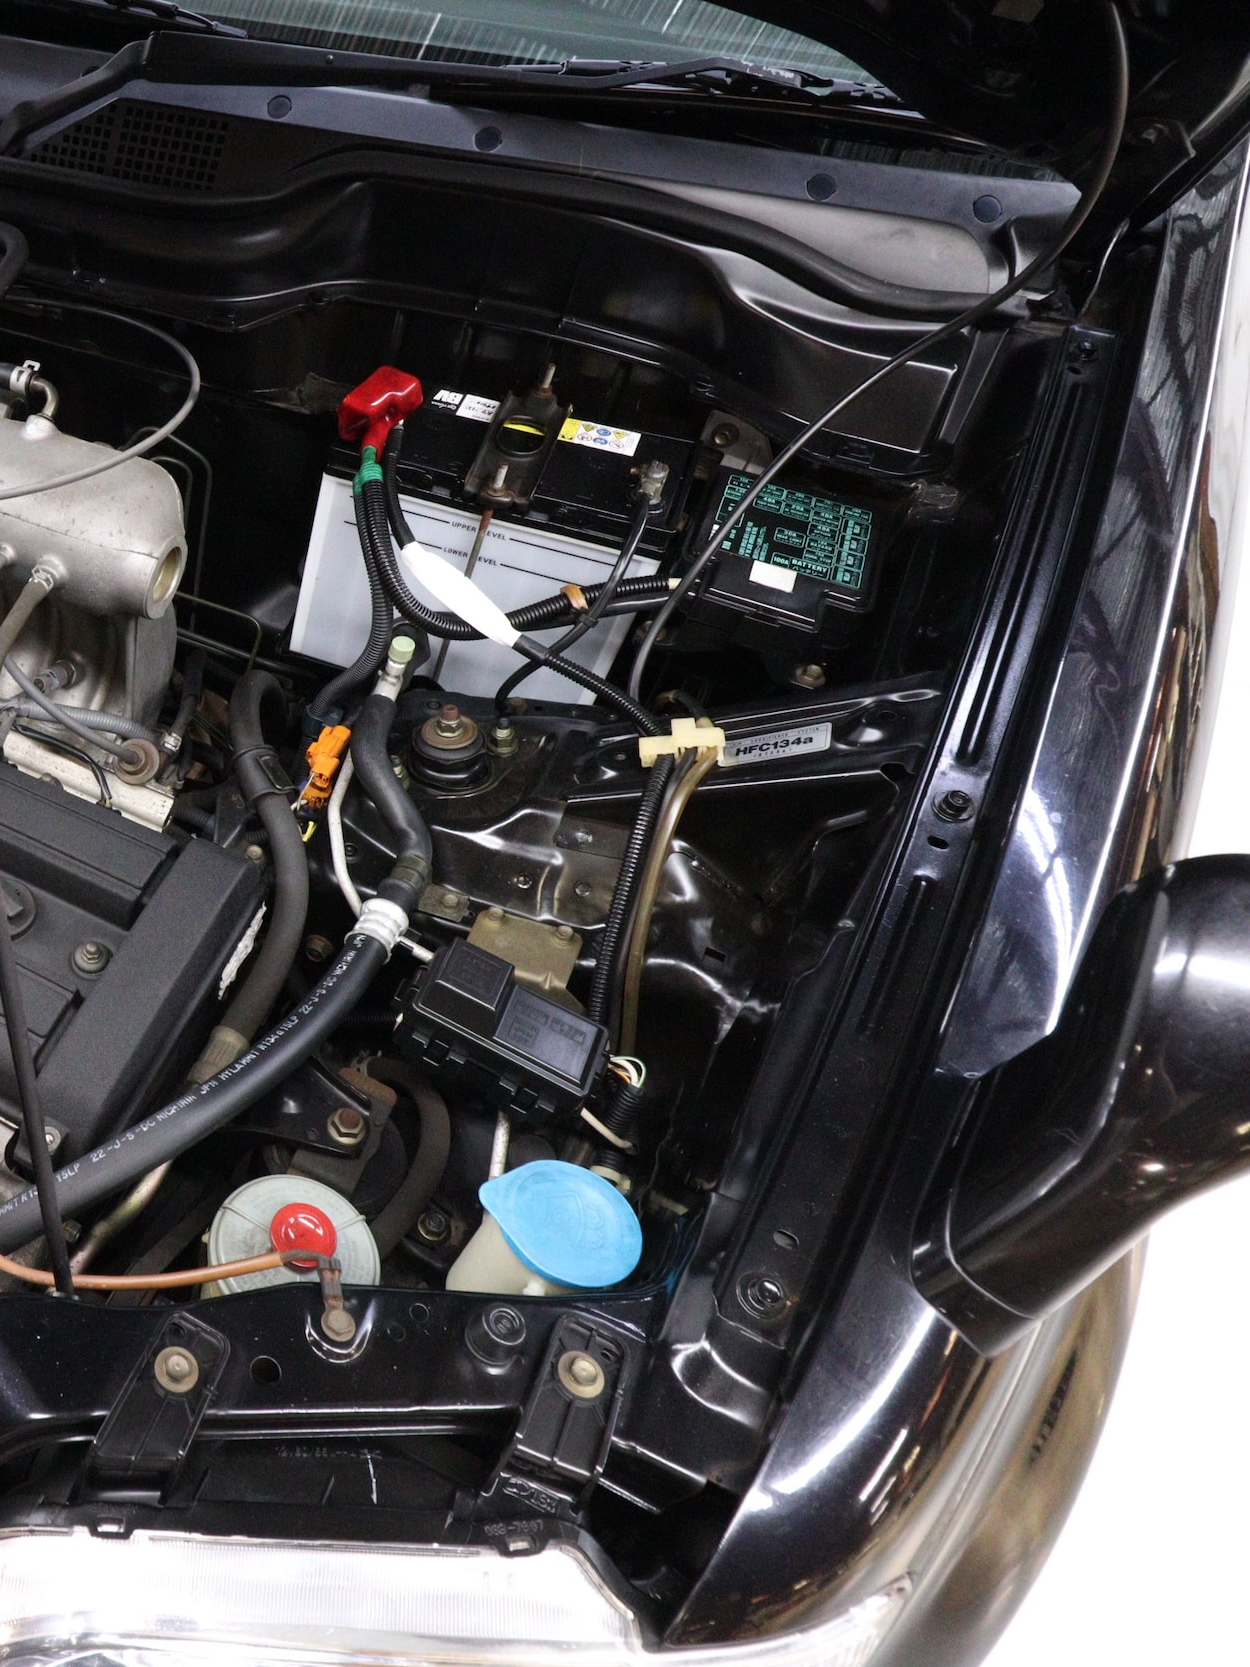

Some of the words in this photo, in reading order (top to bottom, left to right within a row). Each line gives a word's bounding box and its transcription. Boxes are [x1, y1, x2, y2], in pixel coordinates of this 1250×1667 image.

[452, 521, 477, 532] UPPER
[487, 530, 506, 540] EVEL
[443, 547, 469, 558] LOWER
[478, 556, 497, 566] EVEL
[773, 556, 789, 565] 100A
[792, 558, 827, 573] BATTERY
[735, 736, 814, 757] HFC134a
[200, 1079, 219, 1094] JPN
